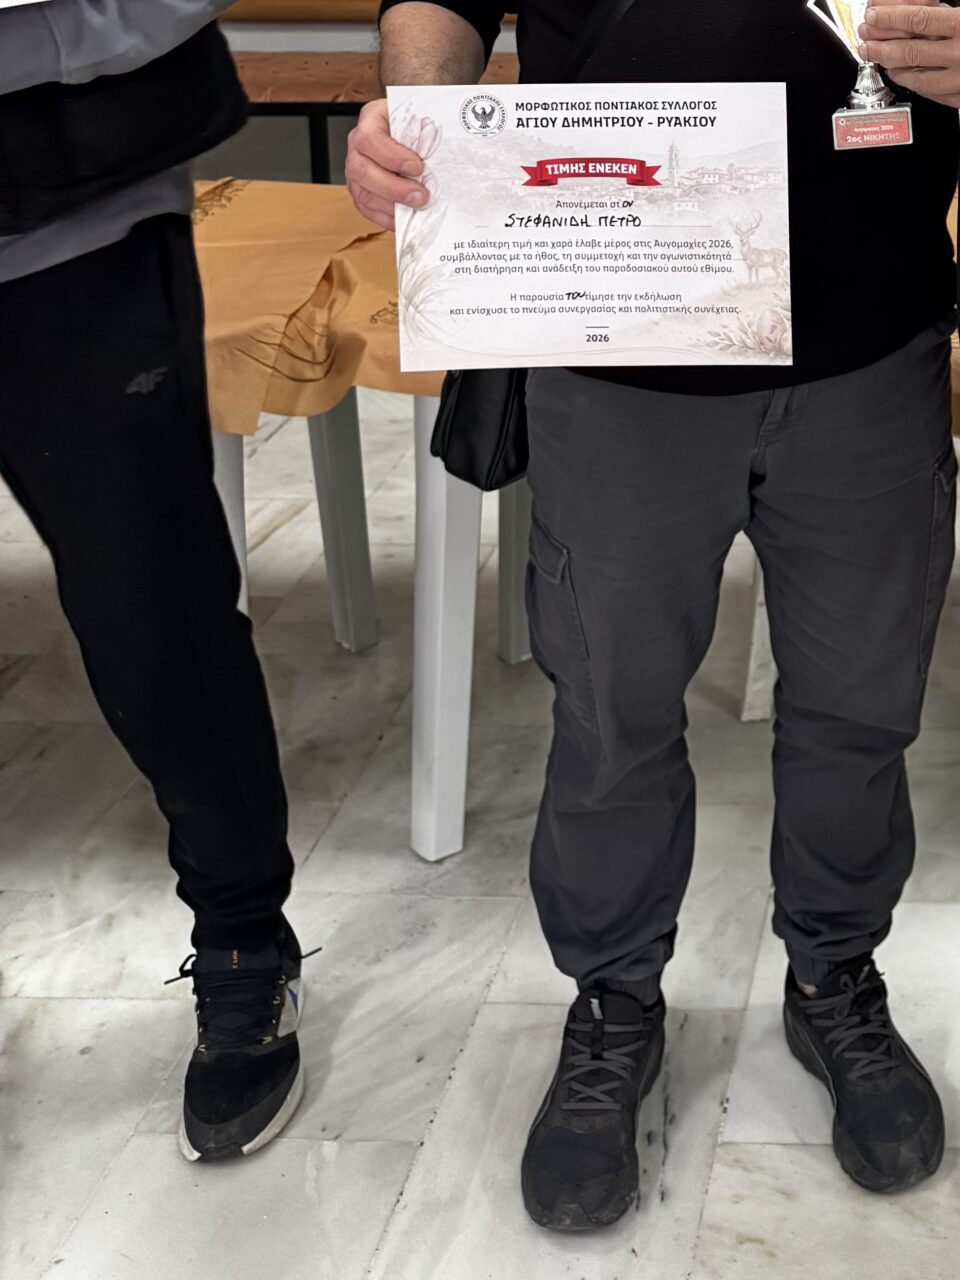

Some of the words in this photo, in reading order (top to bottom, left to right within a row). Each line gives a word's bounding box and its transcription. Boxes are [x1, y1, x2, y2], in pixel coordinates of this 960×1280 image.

[515, 102, 592, 111] ΜΟΡΦΩΤΙΚΟΣ
[594, 101, 659, 111] ΠΟΝΤΙΑΚΟΣ
[661, 101, 718, 110] ΣΥΛΛΟΓΟΣ
[516, 117, 557, 128] ΑΓΙΟΥ
[561, 116, 644, 128] ΔΗΜΗΤΡΙΟΥ
[657, 116, 717, 127] ΡΥΑΚΙΟΥ
[546, 163, 586, 175] ΤΙΜΗΣ
[588, 163, 637, 174] ΕΝΕΚΕΝ
[556, 200, 608, 210] Απονέμεται
[598, 213, 642, 227] ΠΕΤΡΟ
[454, 240, 466, 249] με
[467, 239, 510, 250] ιδιαίτερη
[512, 239, 532, 249] τιμή
[534, 240, 549, 248] και
[550, 239, 573, 249] χαρά
[575, 238, 602, 249] έλαβε
[604, 239, 631, 249] μέρος
[633, 239, 652, 249] στις
[654, 239, 707, 249] Αυγομαχίες
[708, 239, 734, 249] 2026,
[439, 252, 507, 263] συμβάλλοντας
[509, 253, 521, 262] με
[523, 253, 533, 261] το
[534, 252, 560, 262] ήθος,
[562, 253, 572, 262] τη
[574, 252, 625, 262] συμμετοχή
[626, 253, 641, 261] και
[643, 253, 658, 262] την
[660, 251, 732, 261] αγωνιστικότητά
[454, 266, 472, 275] στη
[473, 265, 524, 275] διατήρηση
[525, 265, 540, 273] και
[542, 264, 583, 274] ανάδειξη
[585, 265, 601, 273] του
[602, 264, 669, 274] παραδοσιακού
[670, 264, 699, 273] αυτού
[700, 264, 735, 274] εθίμου.
[510, 293, 517, 301] Η
[519, 292, 564, 302] παρουσία
[616, 293, 633, 302] την
[634, 292, 682, 302] εκδήλωση
[449, 306, 465, 315] και
[466, 305, 508, 316] ενίσχυσε
[510, 306, 520, 314] το
[522, 305, 556, 315] πνεύμα
[558, 304, 617, 315] συνεργασίας
[618, 305, 633, 313] και
[634, 304, 693, 314] πολιτιστικής
[694, 304, 742, 314] συνέχειας.
[586, 334, 610, 343] 2026
